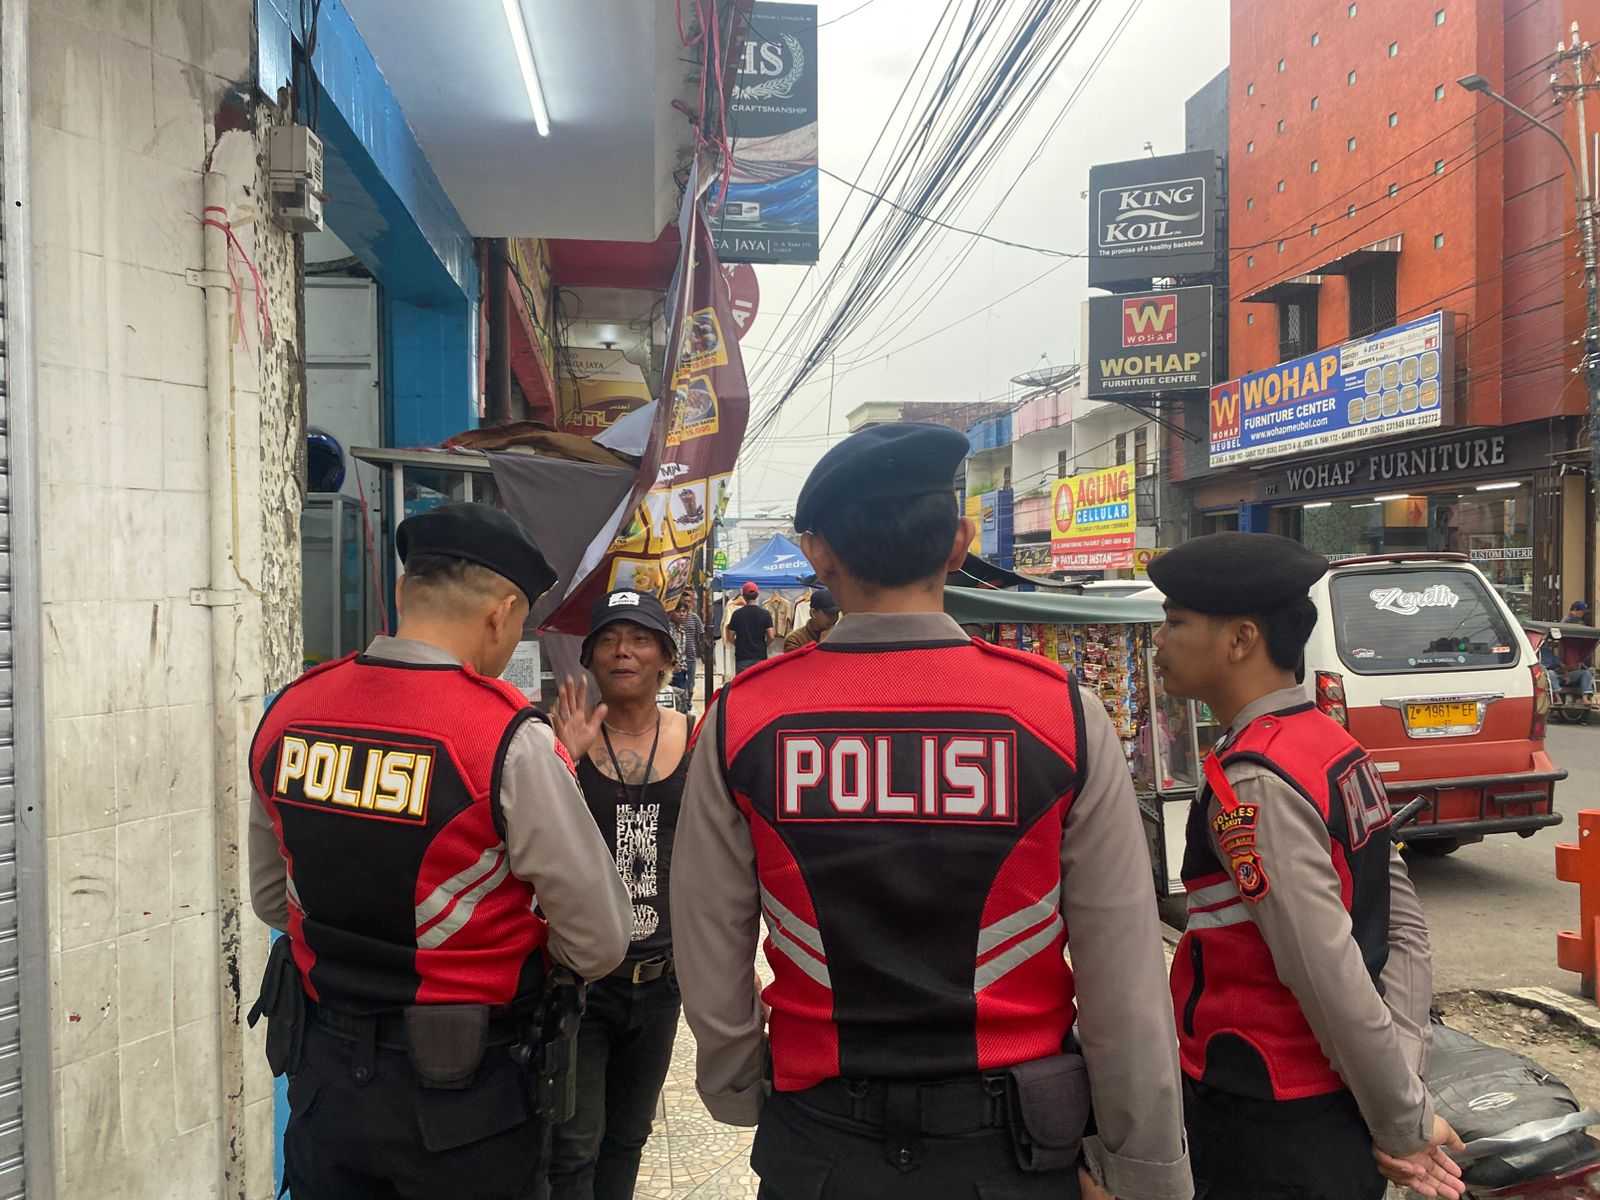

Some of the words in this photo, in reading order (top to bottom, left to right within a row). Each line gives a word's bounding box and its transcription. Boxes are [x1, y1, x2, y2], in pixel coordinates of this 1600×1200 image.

[732, 104, 807, 113] CRAFTSMANSHIP
[1118, 186, 1194, 210] KING
[1105, 221, 1173, 242] KOIL
[735, 238, 766, 252] JAYA
[1111, 247, 1136, 256] promise
[1150, 242, 1172, 251] healthy
[1173, 240, 1204, 249] backbone
[1127, 333, 1173, 343] WOHAP
[1100, 352, 1201, 378] WOHAP
[1102, 376, 1157, 388] FURNITURE
[1158, 374, 1197, 385] CENTER
[1243, 355, 1338, 411] WOHAP
[1244, 408, 1294, 430] FURNITURE
[1296, 398, 1336, 418] CENTER
[1213, 427, 1238, 440] WOHAP
[1211, 439, 1240, 452] MEUBEL
[1369, 436, 1505, 480] FURNITURE
[1076, 469, 1129, 507] AGUNG
[1076, 504, 1129, 524] CELLULAR
[1471, 550, 1502, 559] CUSTOM
[1409, 705, 1416, 720] Z
[1425, 704, 1451, 718] 1961
[277, 735, 431, 817] POLISI
[784, 735, 1009, 818] POLISI
[616, 803, 660, 814] HELO!
